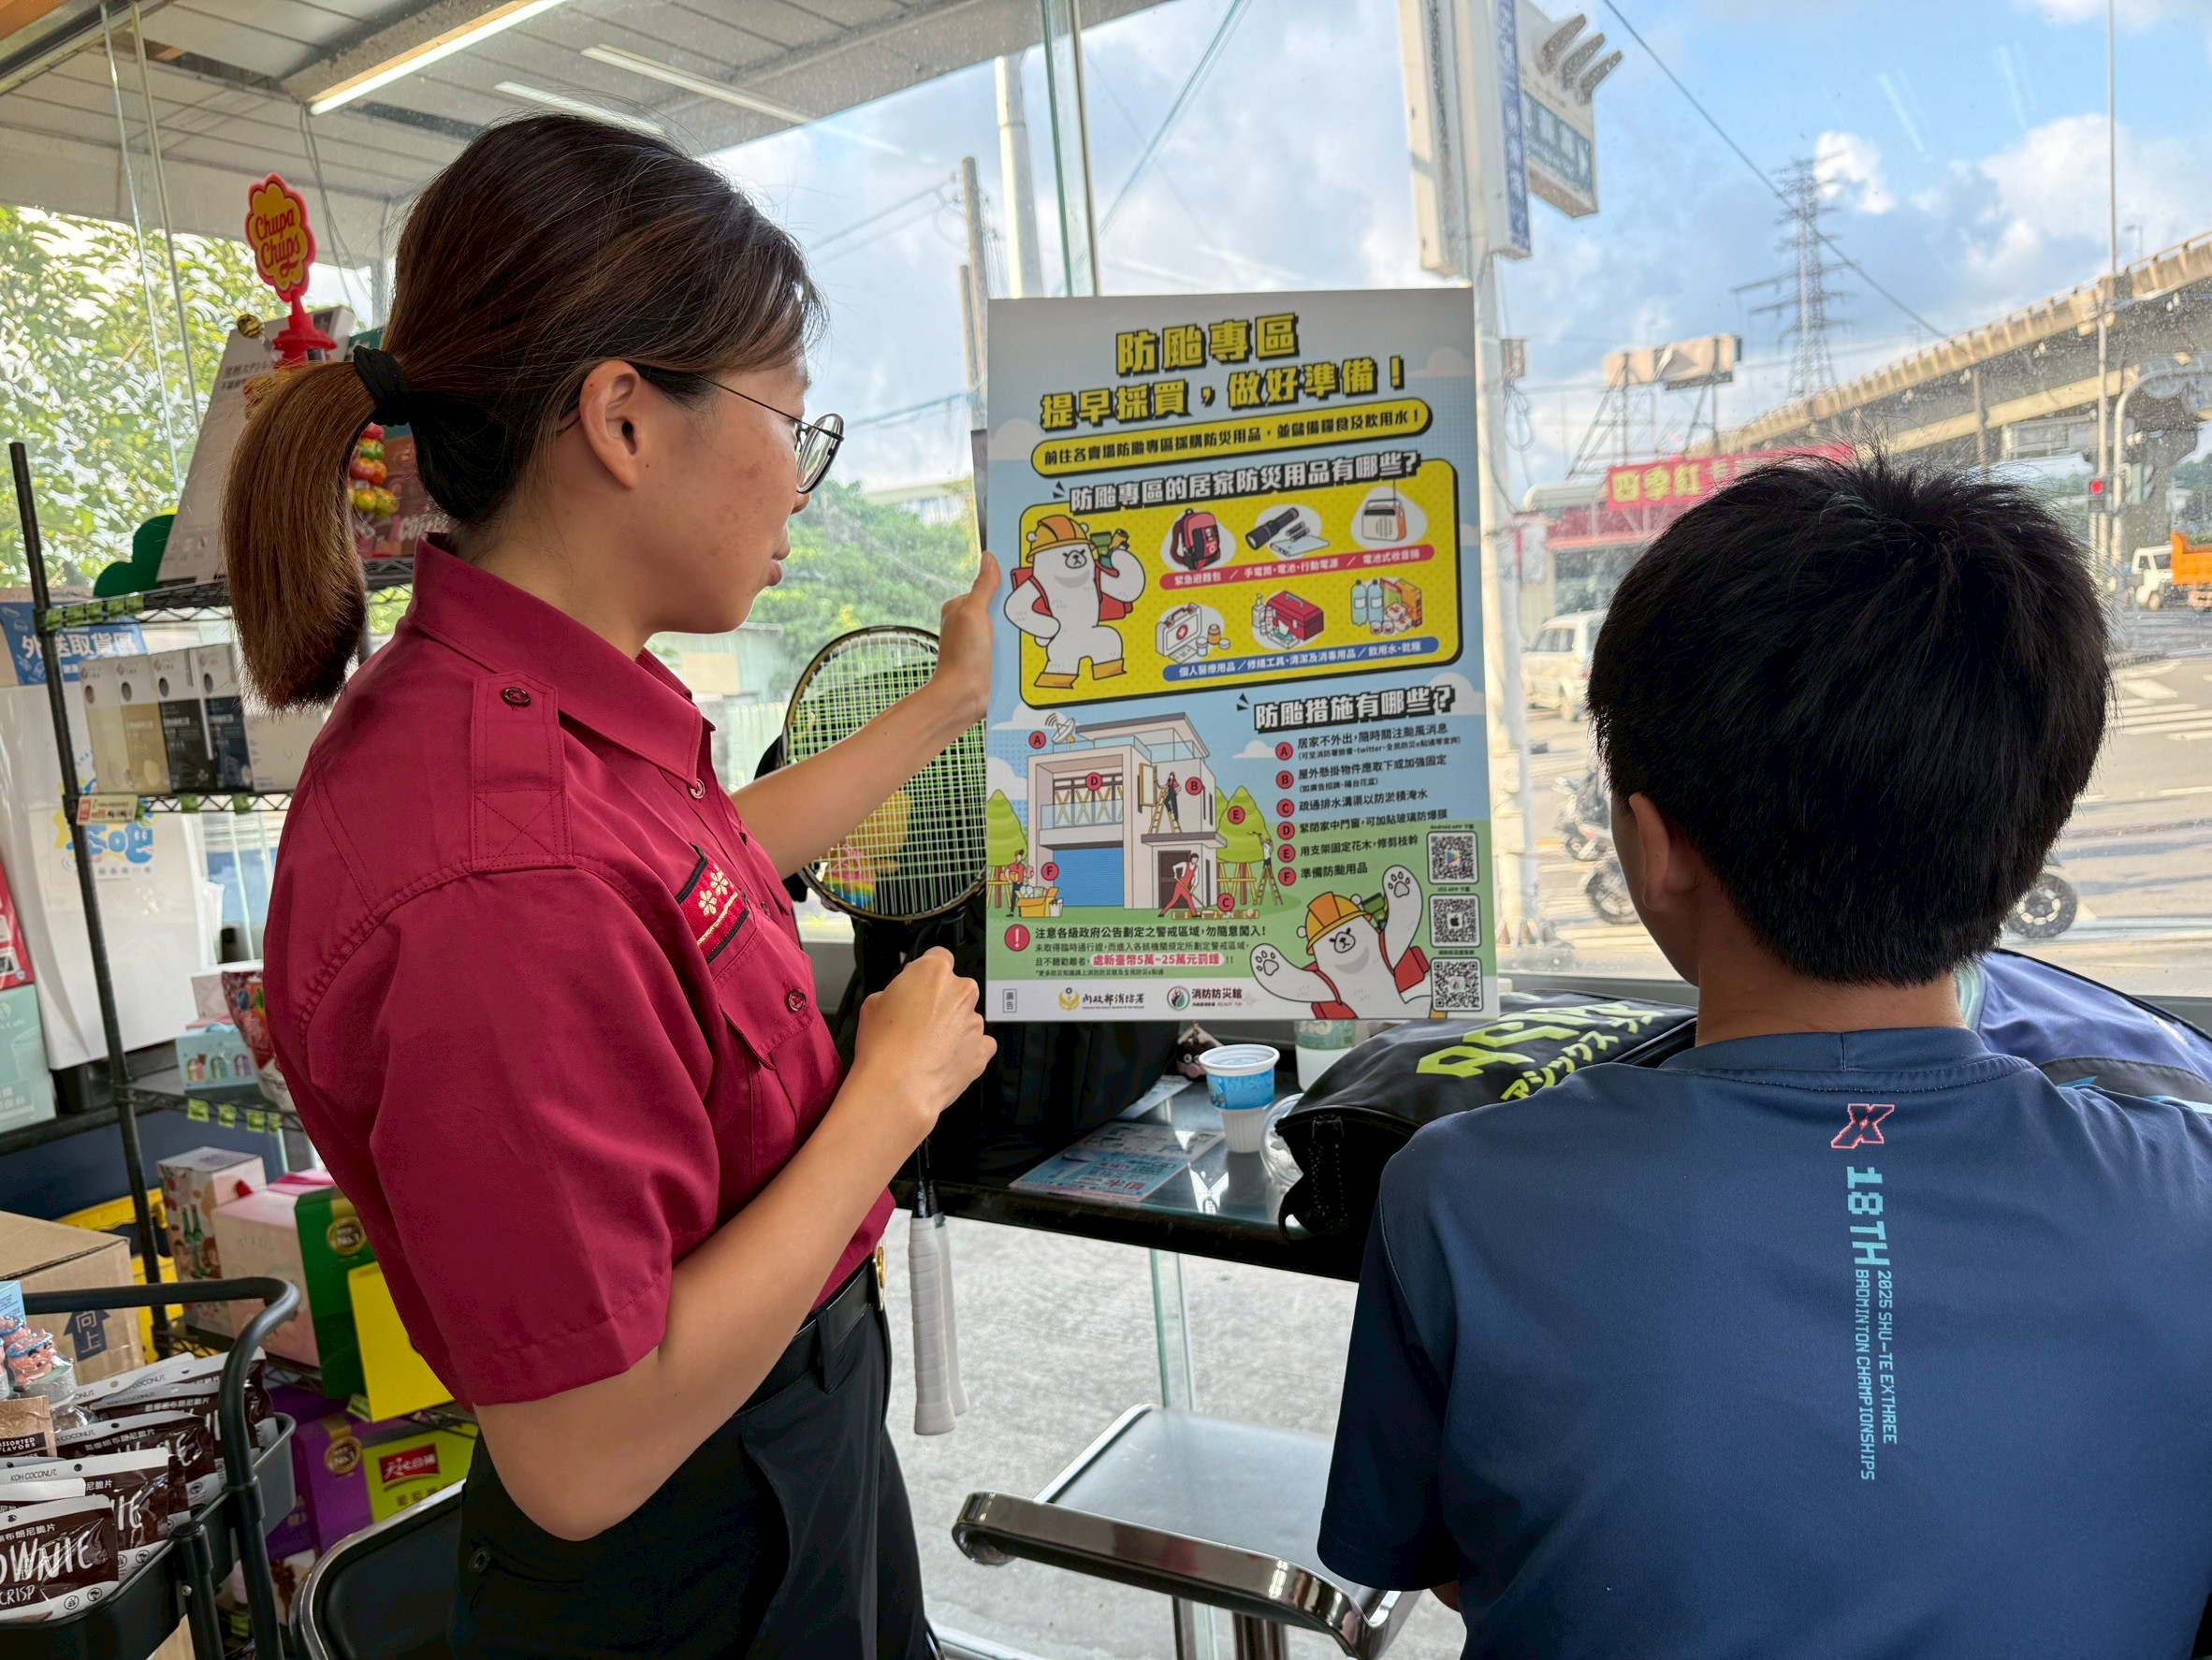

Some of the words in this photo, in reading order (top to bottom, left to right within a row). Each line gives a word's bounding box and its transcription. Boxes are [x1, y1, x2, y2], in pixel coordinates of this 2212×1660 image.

[255, 208, 295, 240] Chupa
[262, 233, 300, 277] Chups
[1115, 313, 1300, 376] 防颱專區
[1254, 684, 1455, 734] 防颱措施有哪些?
[1301, 862, 1368, 880] 準備防颱用品
[1192, 987, 1243, 999] 消防防災館
[1846, 1166, 1890, 1266] 18TH
[1855, 1269, 1870, 1353] BADMINTON
[1878, 1270, 1892, 1309] 2025
[76, 1311, 101, 1353] 向上
[1878, 1312, 1894, 1371] SHU-TE
[1856, 1356, 1875, 1480] CHAMPIONSHIPS
[1880, 1375, 1898, 1445] EXTHREE
[0, 1584, 36, 1606] CRISP
